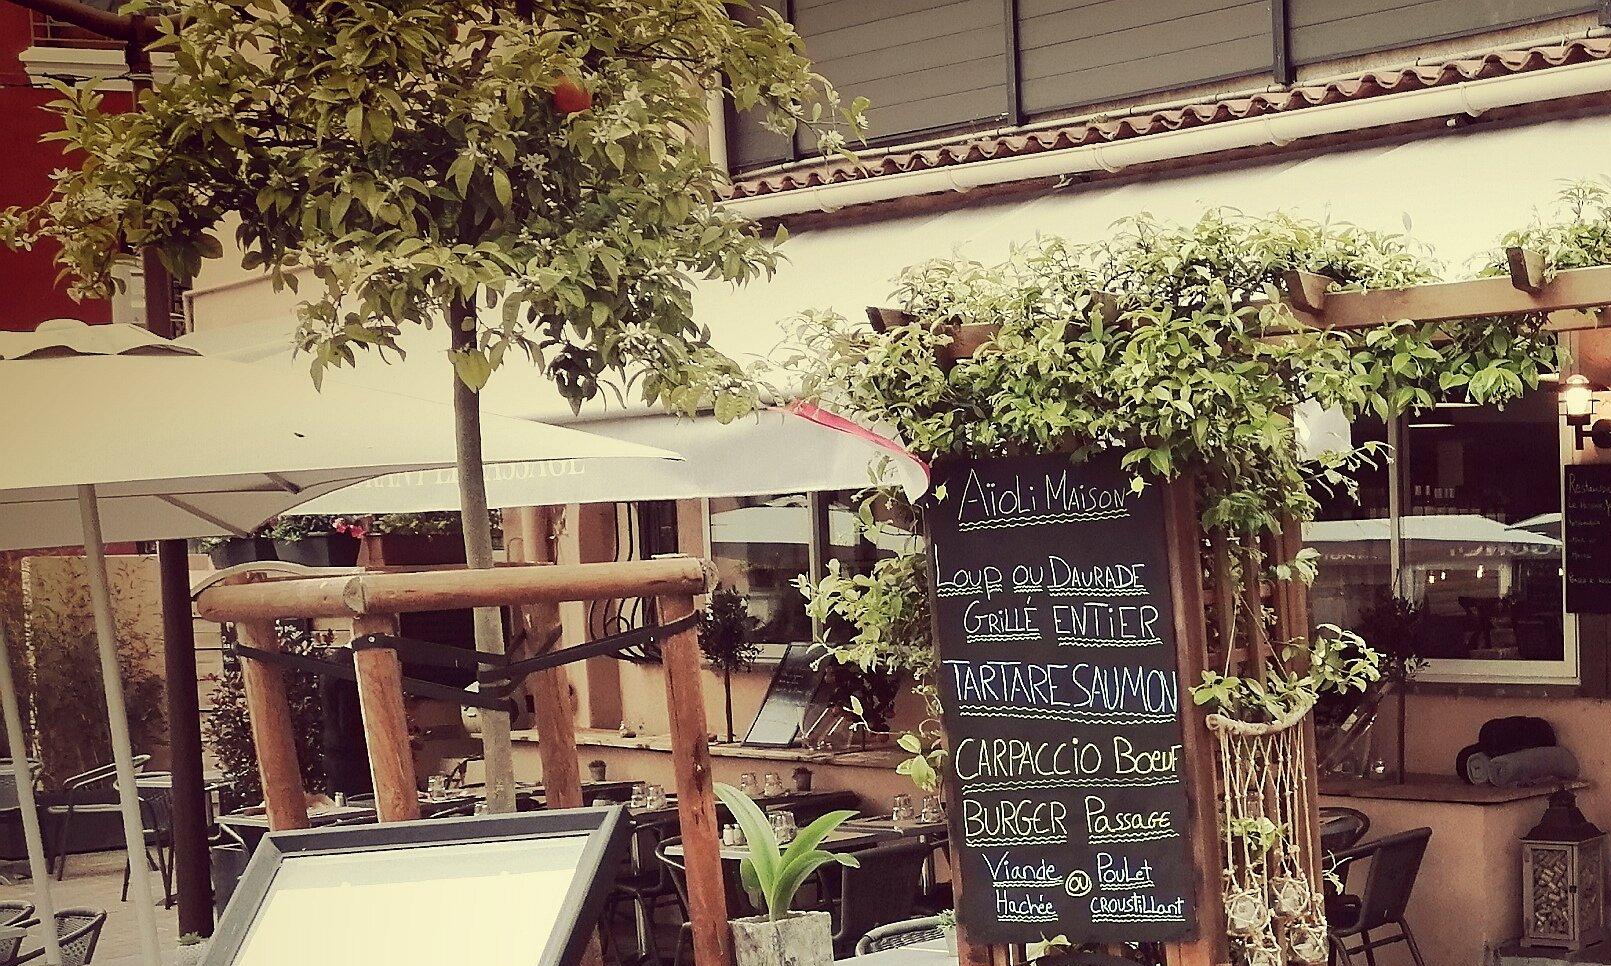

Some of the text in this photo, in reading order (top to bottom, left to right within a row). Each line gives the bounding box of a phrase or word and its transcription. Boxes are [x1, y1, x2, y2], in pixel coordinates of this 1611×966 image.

[942, 659, 1178, 713] TARTARE SAUMON
[962, 799, 1068, 837] BURGER
[981, 851, 1062, 882] Viande
[996, 889, 1057, 916] Hachée
